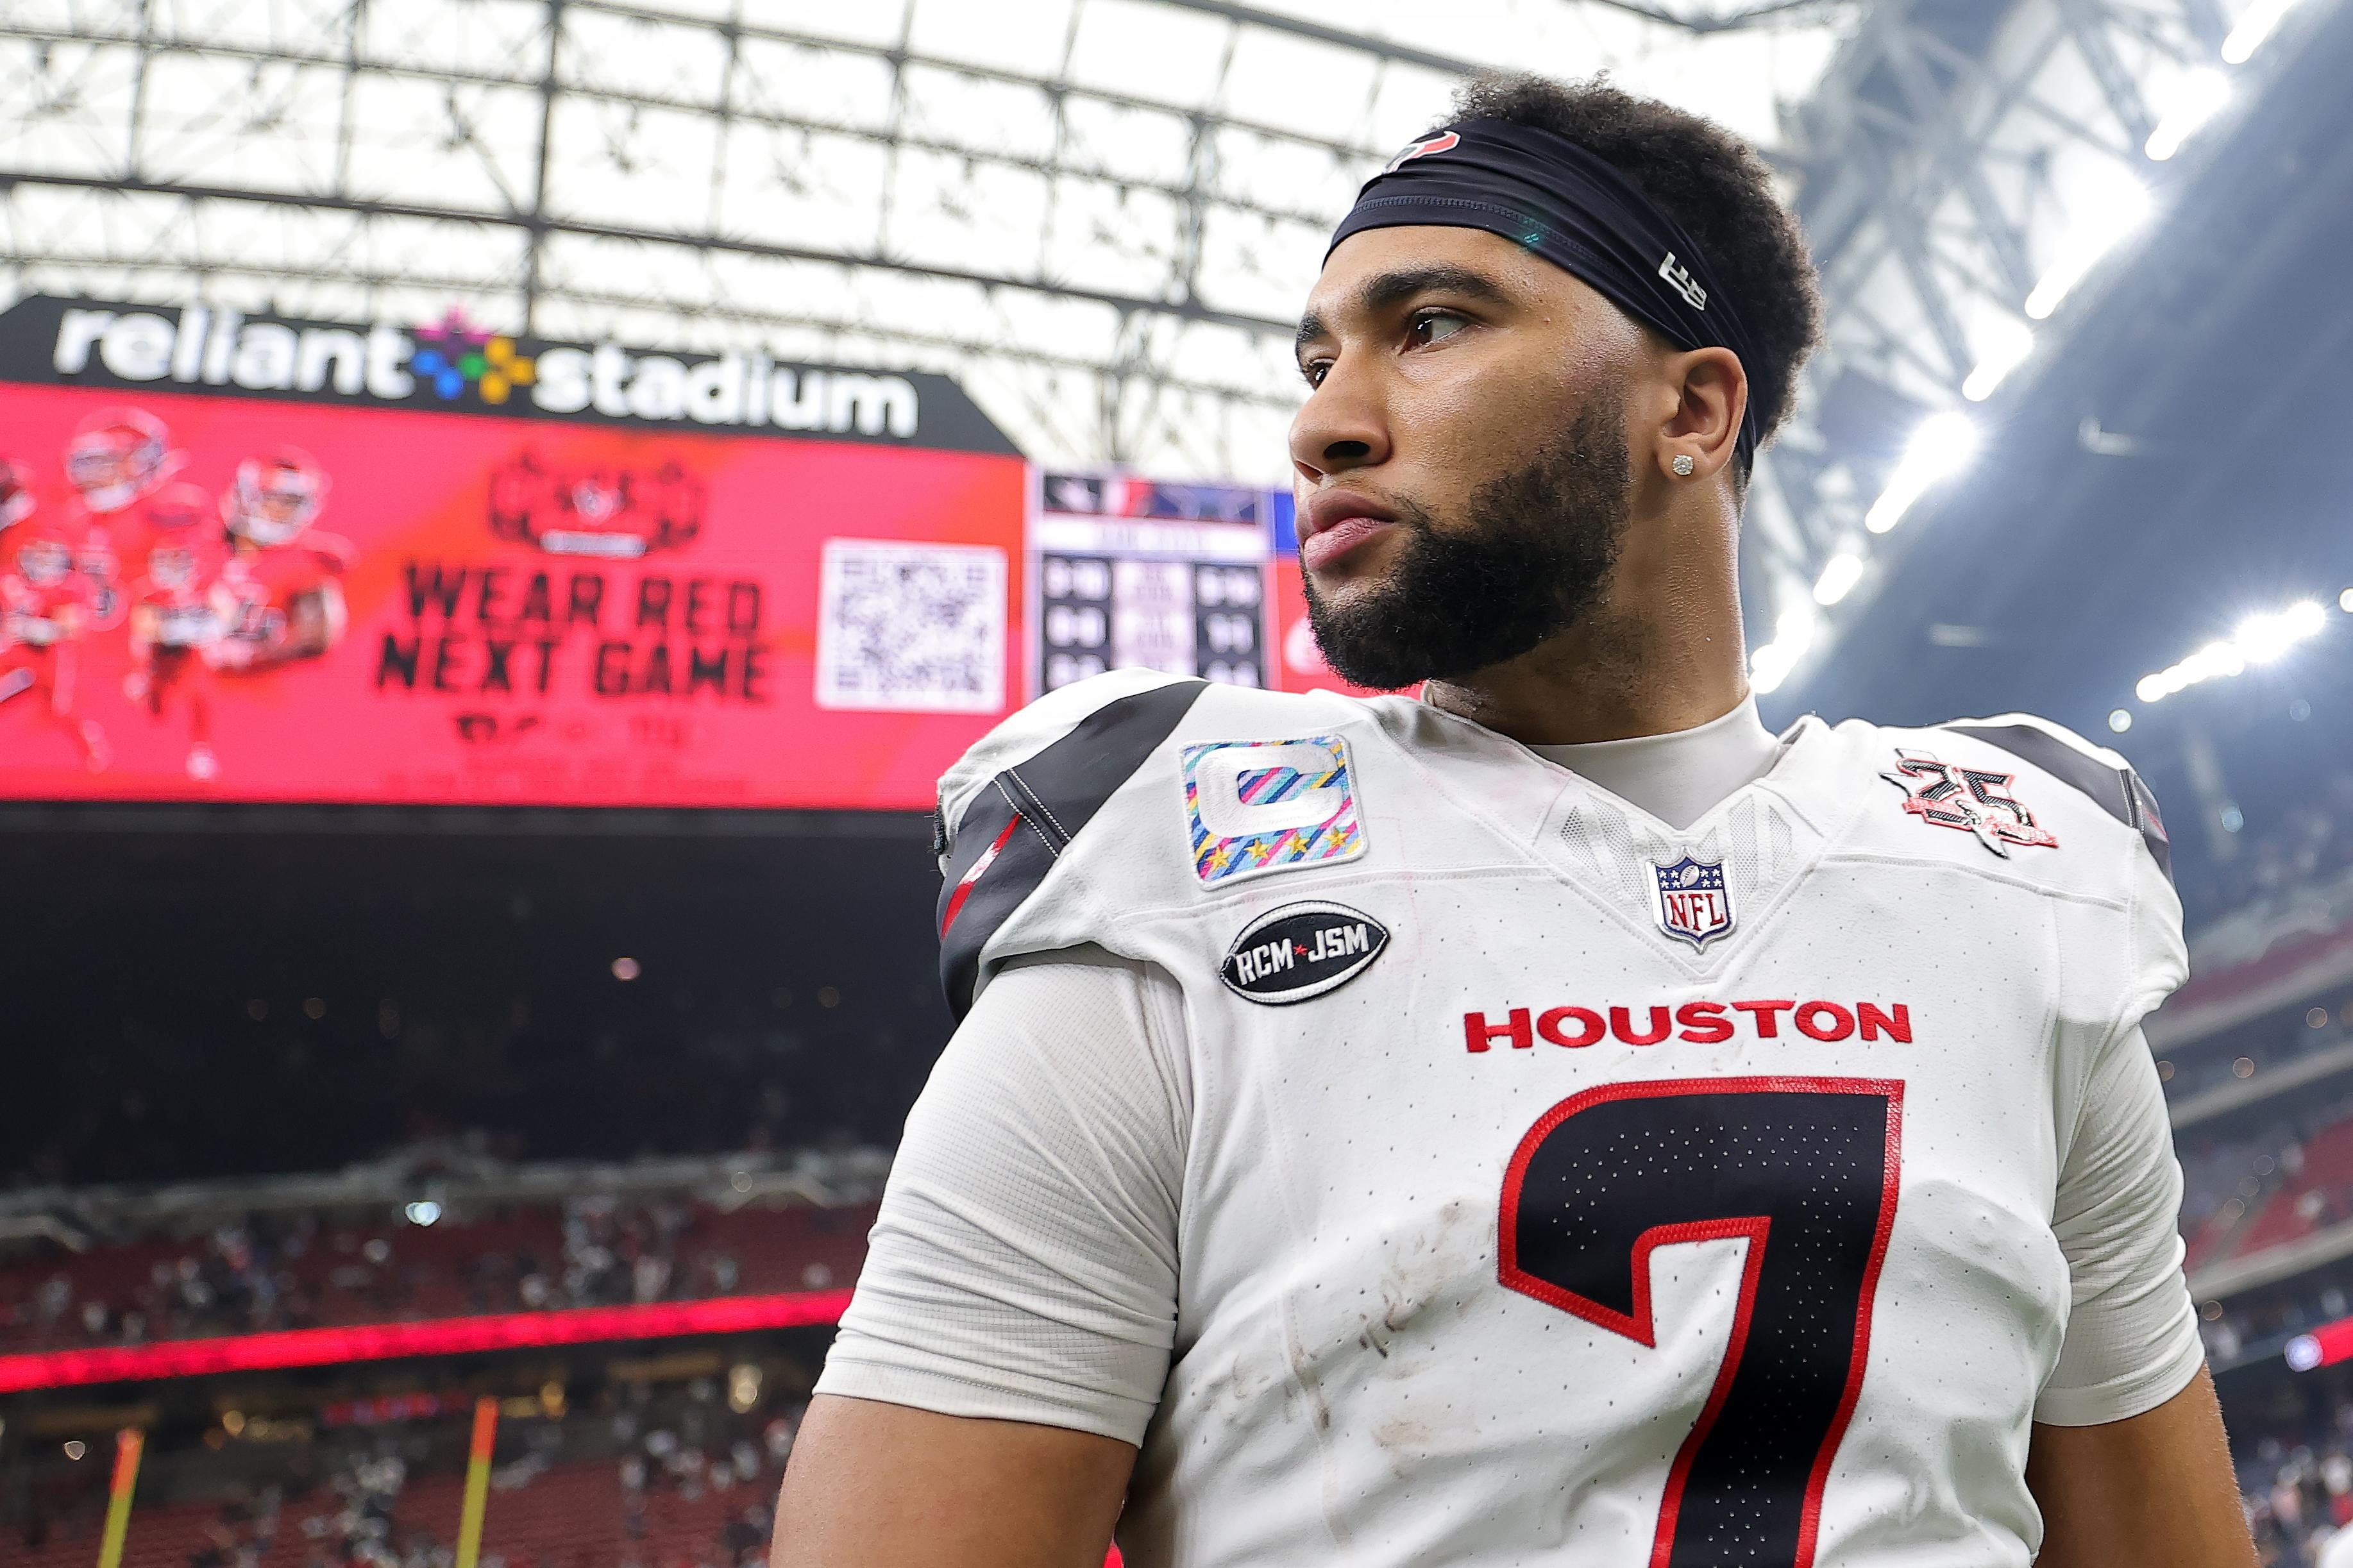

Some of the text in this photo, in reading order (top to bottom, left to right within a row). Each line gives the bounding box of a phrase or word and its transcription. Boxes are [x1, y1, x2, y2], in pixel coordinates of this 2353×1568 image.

[53, 305, 920, 439] reliant stadium
[406, 559, 762, 635] WEAR RED
[375, 631, 771, 704] NEXT GAME
[1193, 744, 1344, 838] C
[1896, 758, 2039, 847] 25
[1666, 893, 1725, 932] NFL
[1235, 922, 1371, 986] RCM JSM
[1463, 1000, 1912, 1053] HOUSTON
[1497, 1076, 1906, 1568] 7
